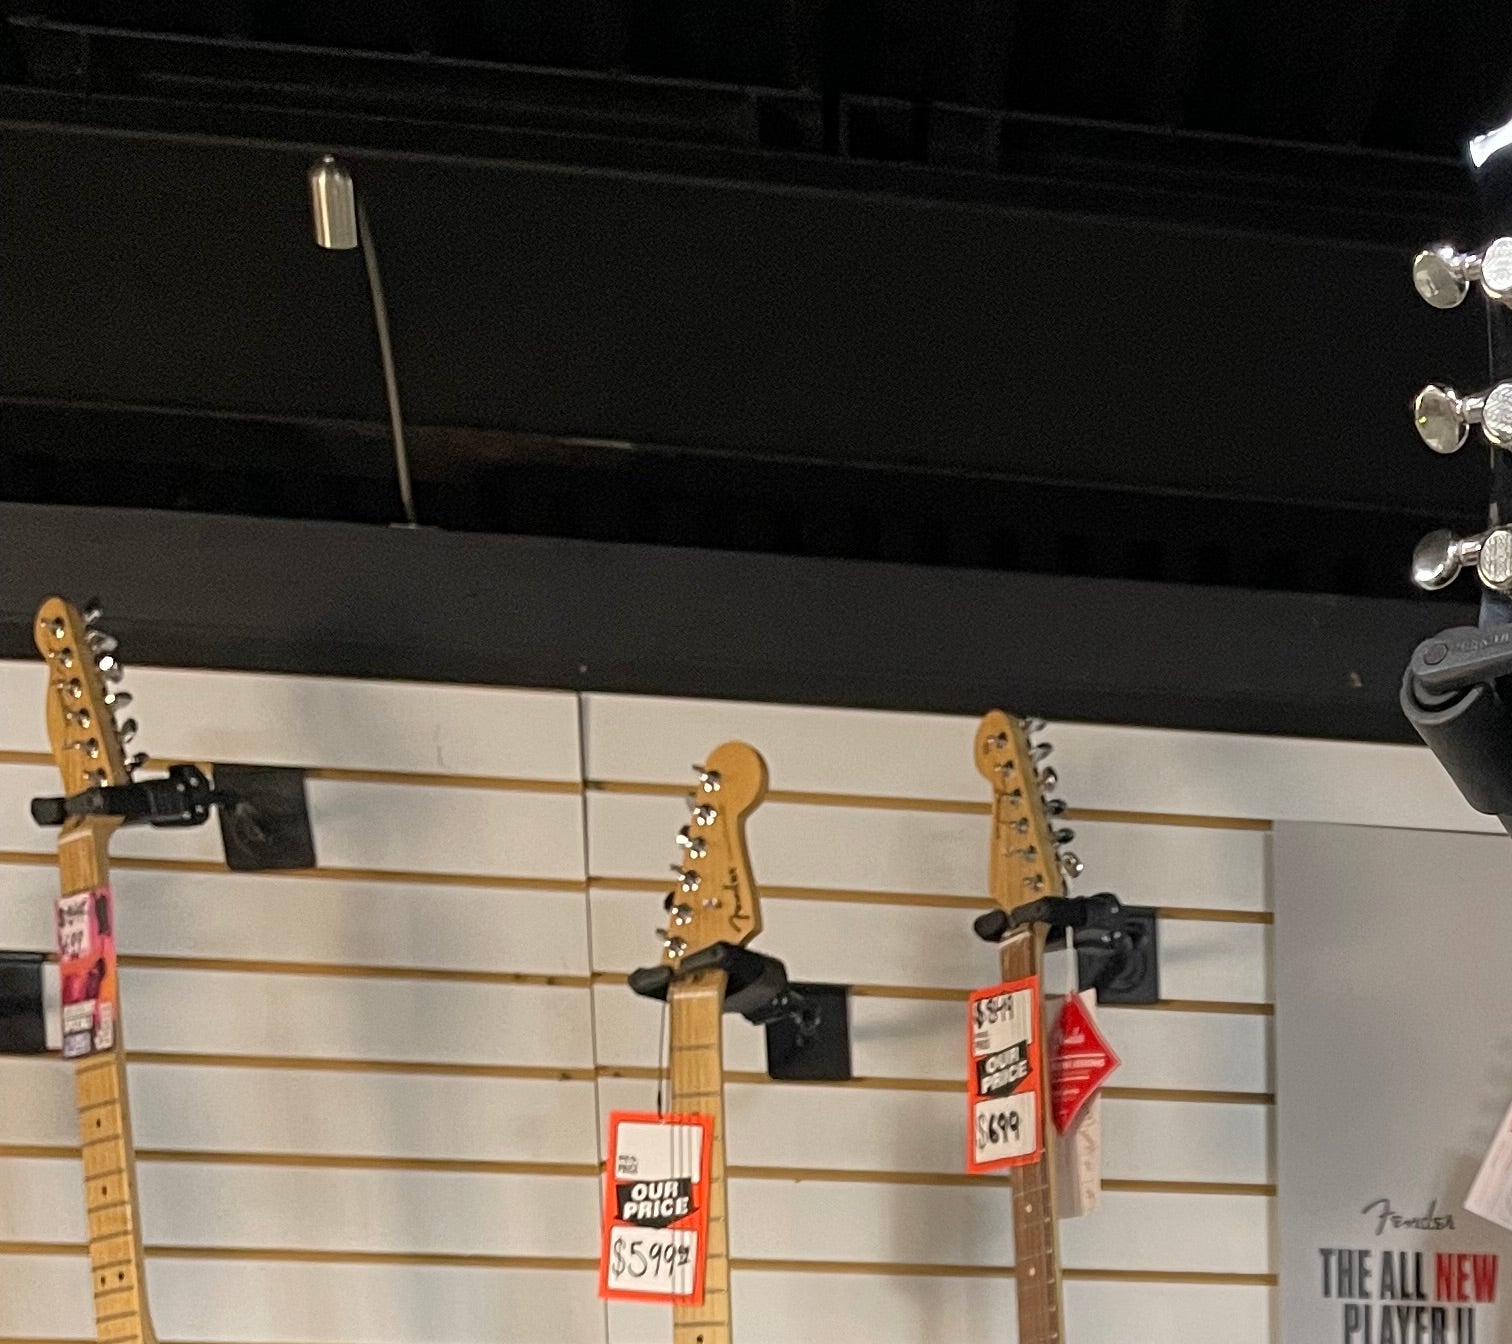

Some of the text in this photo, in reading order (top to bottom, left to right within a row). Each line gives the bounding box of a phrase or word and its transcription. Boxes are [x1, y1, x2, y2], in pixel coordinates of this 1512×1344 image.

[981, 1060, 1029, 1094] PRICE
[985, 1046, 1020, 1074] OUR
[978, 1110, 1021, 1150] $699
[631, 1181, 679, 1201] OUR
[623, 1197, 689, 1221] PRICE
[1361, 1198, 1456, 1236] Fender
[1319, 1248, 1498, 1304] THE ALL NEW
